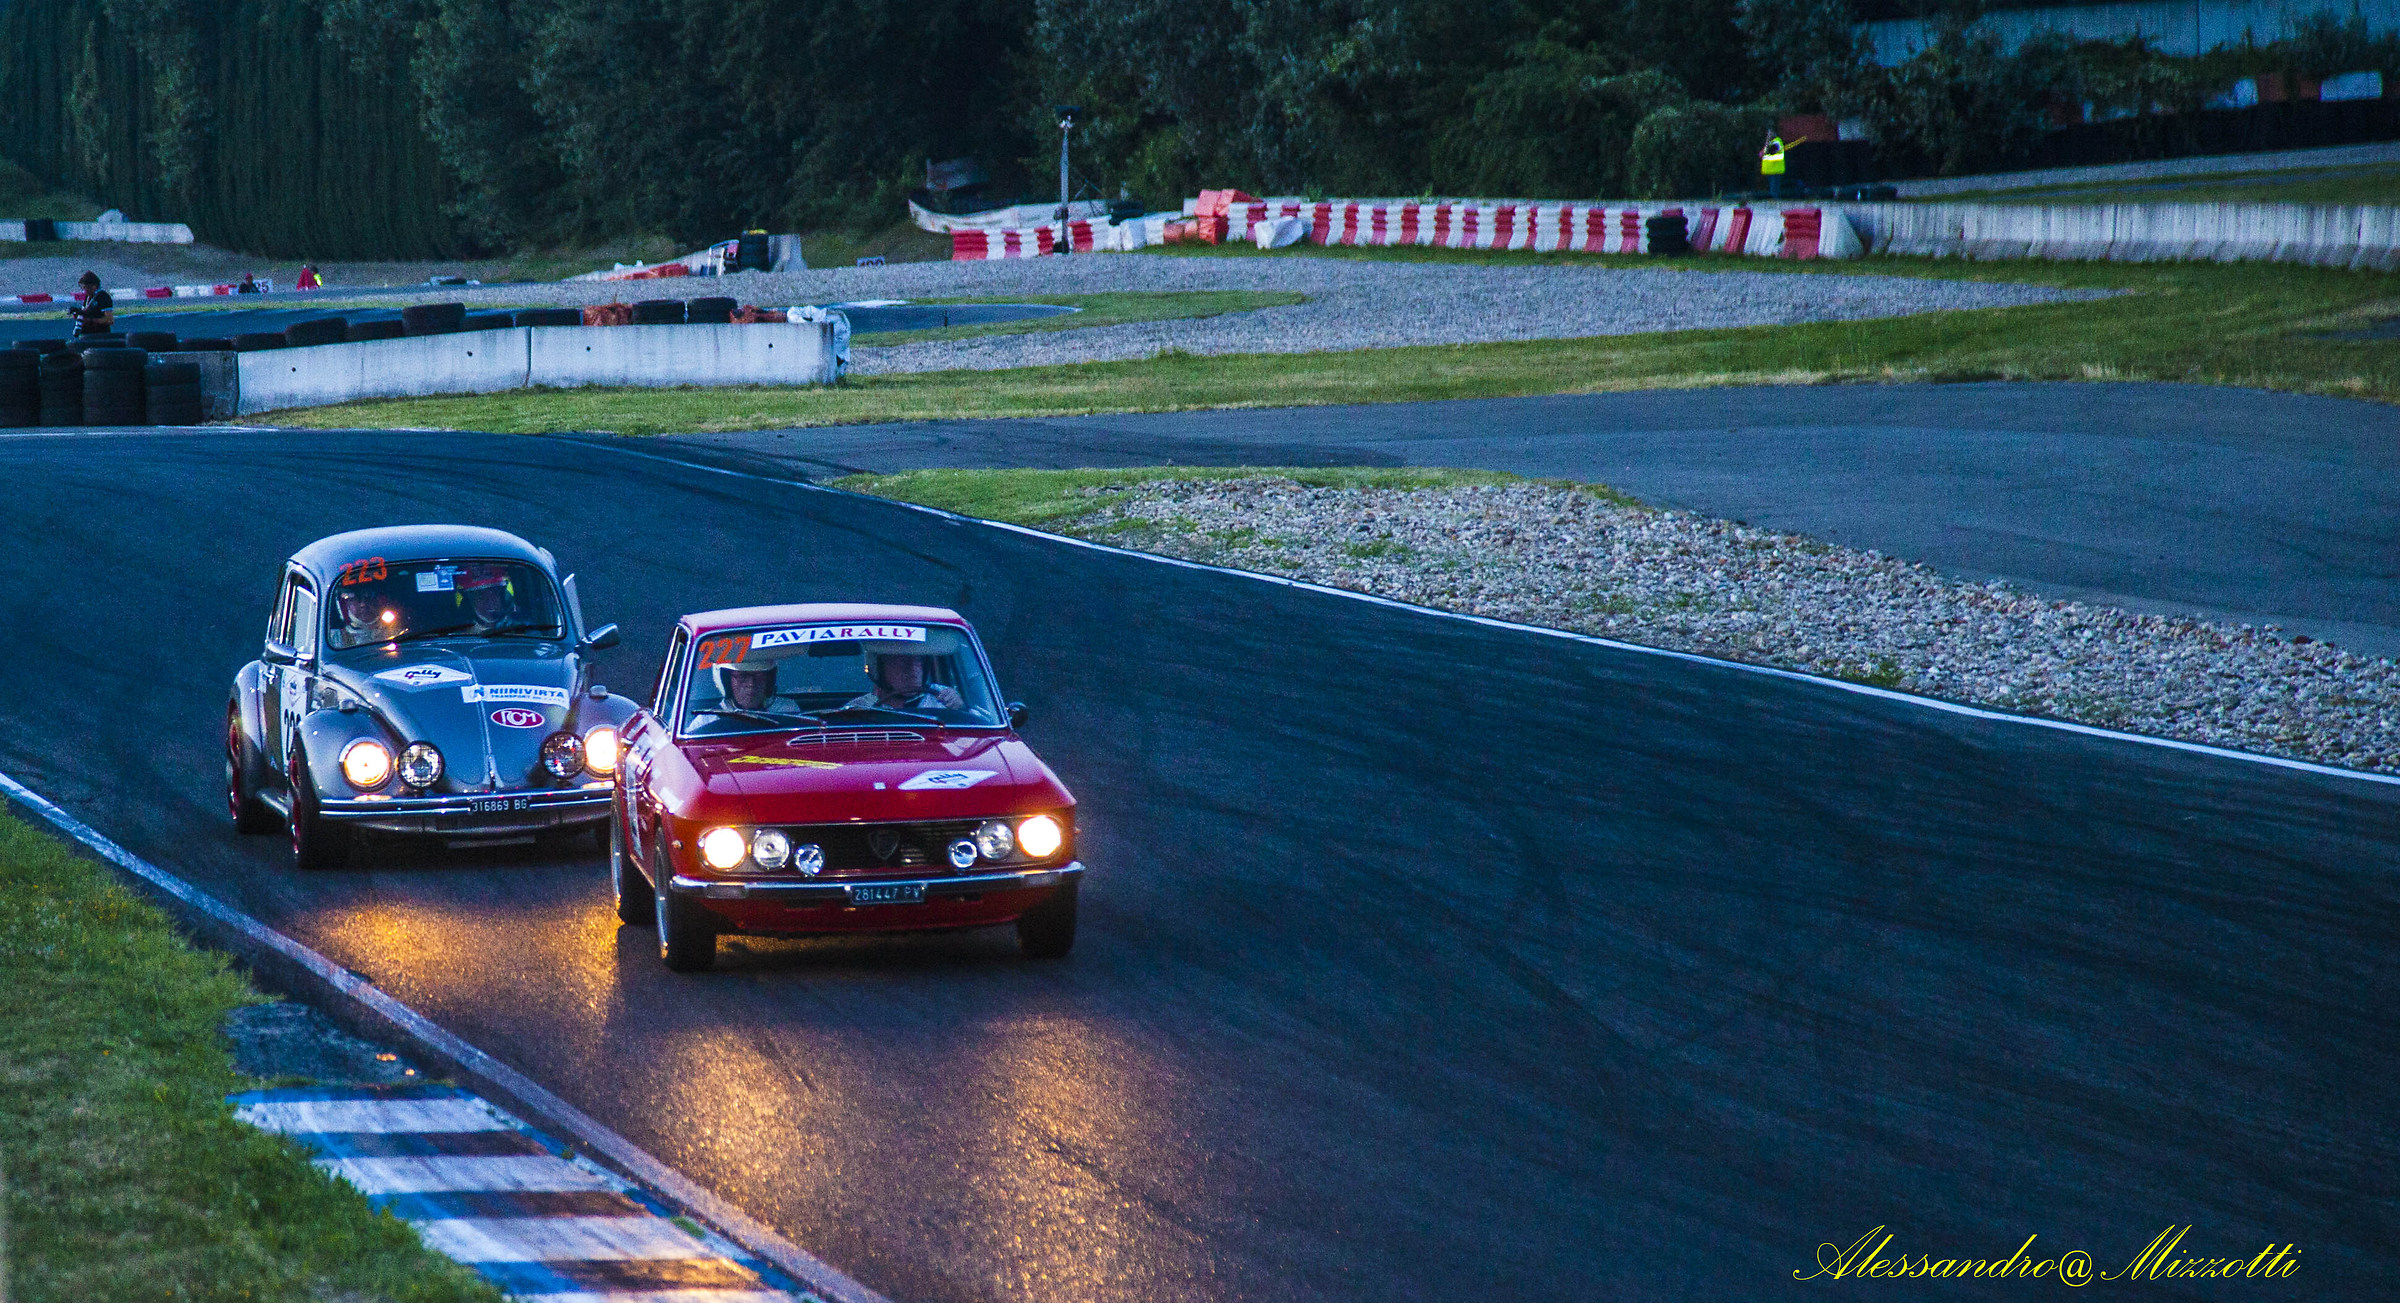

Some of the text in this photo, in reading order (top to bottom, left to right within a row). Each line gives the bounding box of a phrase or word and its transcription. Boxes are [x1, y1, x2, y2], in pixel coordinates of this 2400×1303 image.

[339, 556, 387, 586] 223
[698, 635, 752, 670] 227
[489, 688, 564, 697] NIINIVIRTA
[471, 799, 527, 811] 316869 BG
